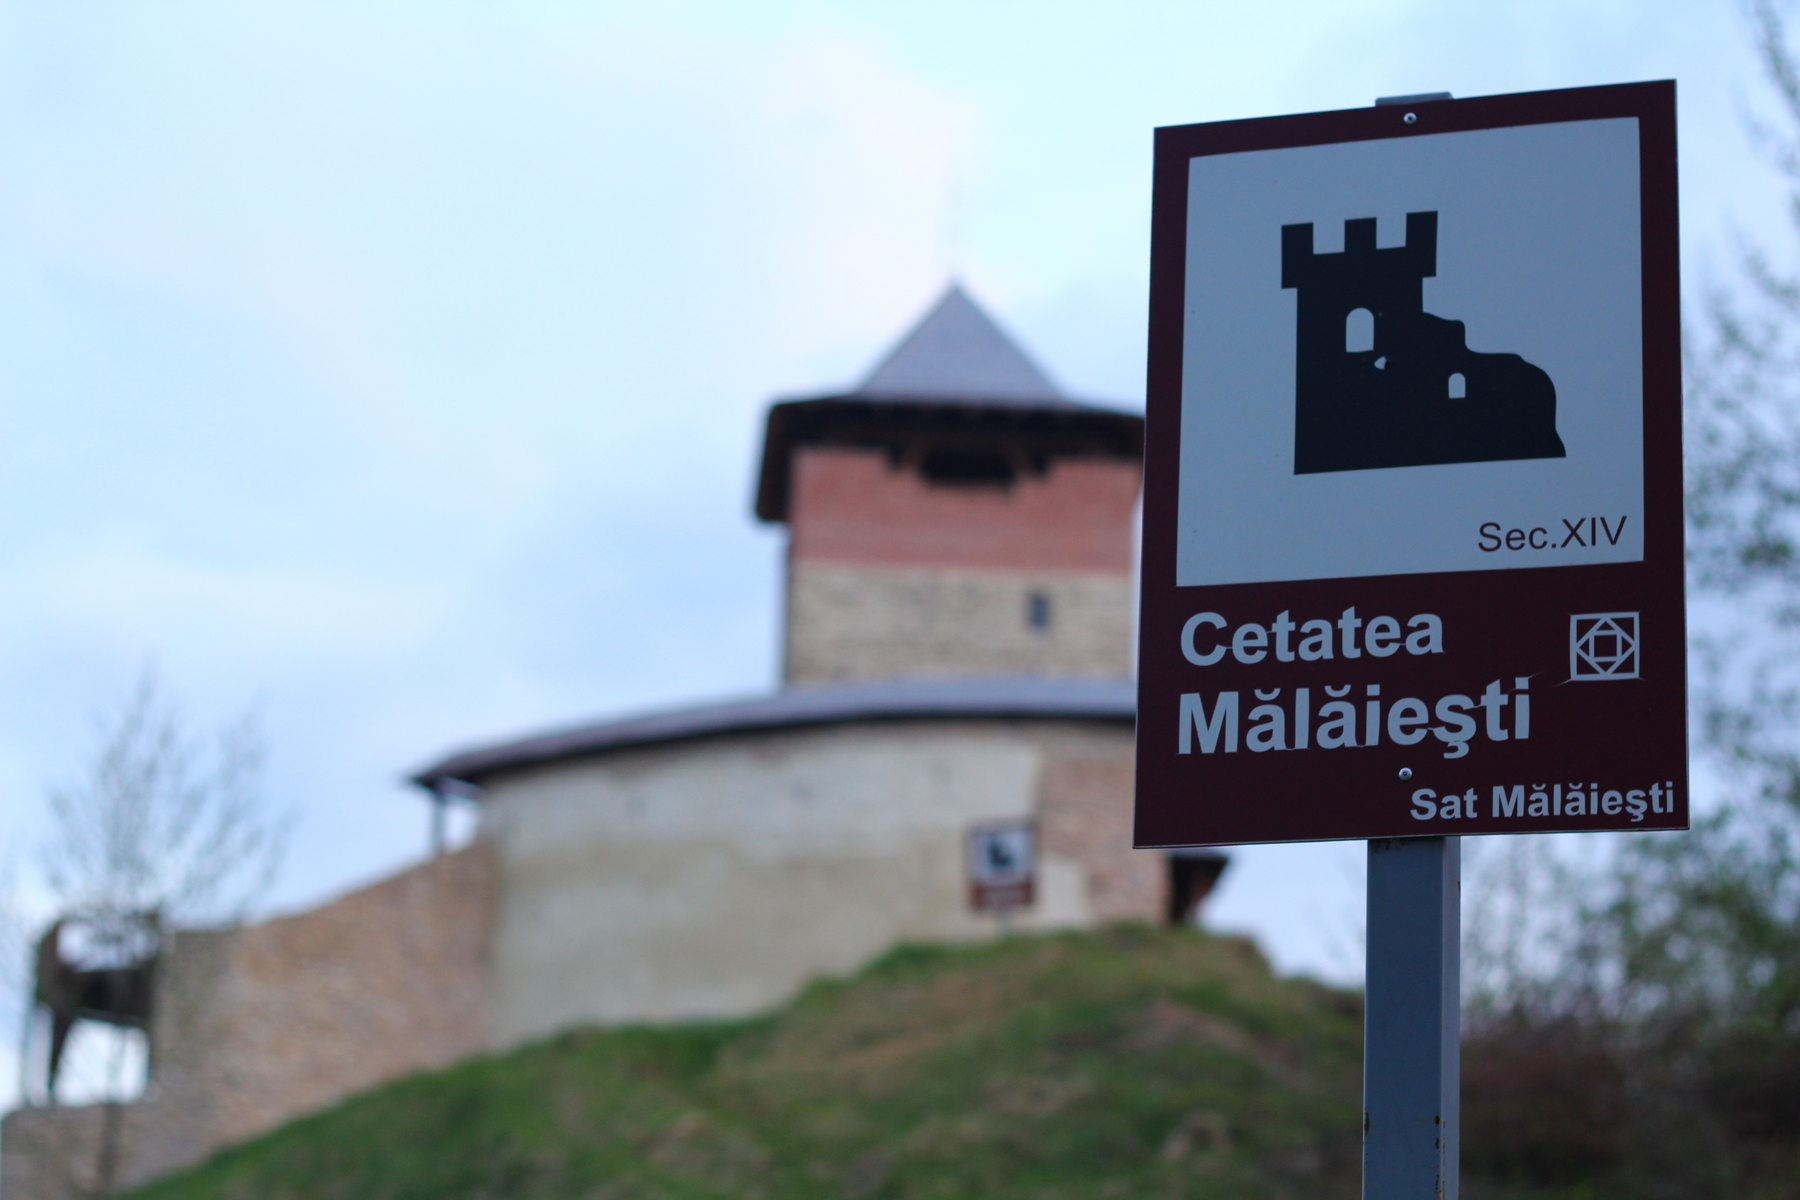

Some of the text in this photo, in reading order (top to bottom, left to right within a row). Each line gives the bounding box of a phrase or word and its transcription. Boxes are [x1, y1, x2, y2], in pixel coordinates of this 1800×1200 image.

[1180, 606, 1443, 666] Cetatea
[1178, 677, 1531, 759] Mălăieşti
[1410, 787, 1478, 820] Sat
